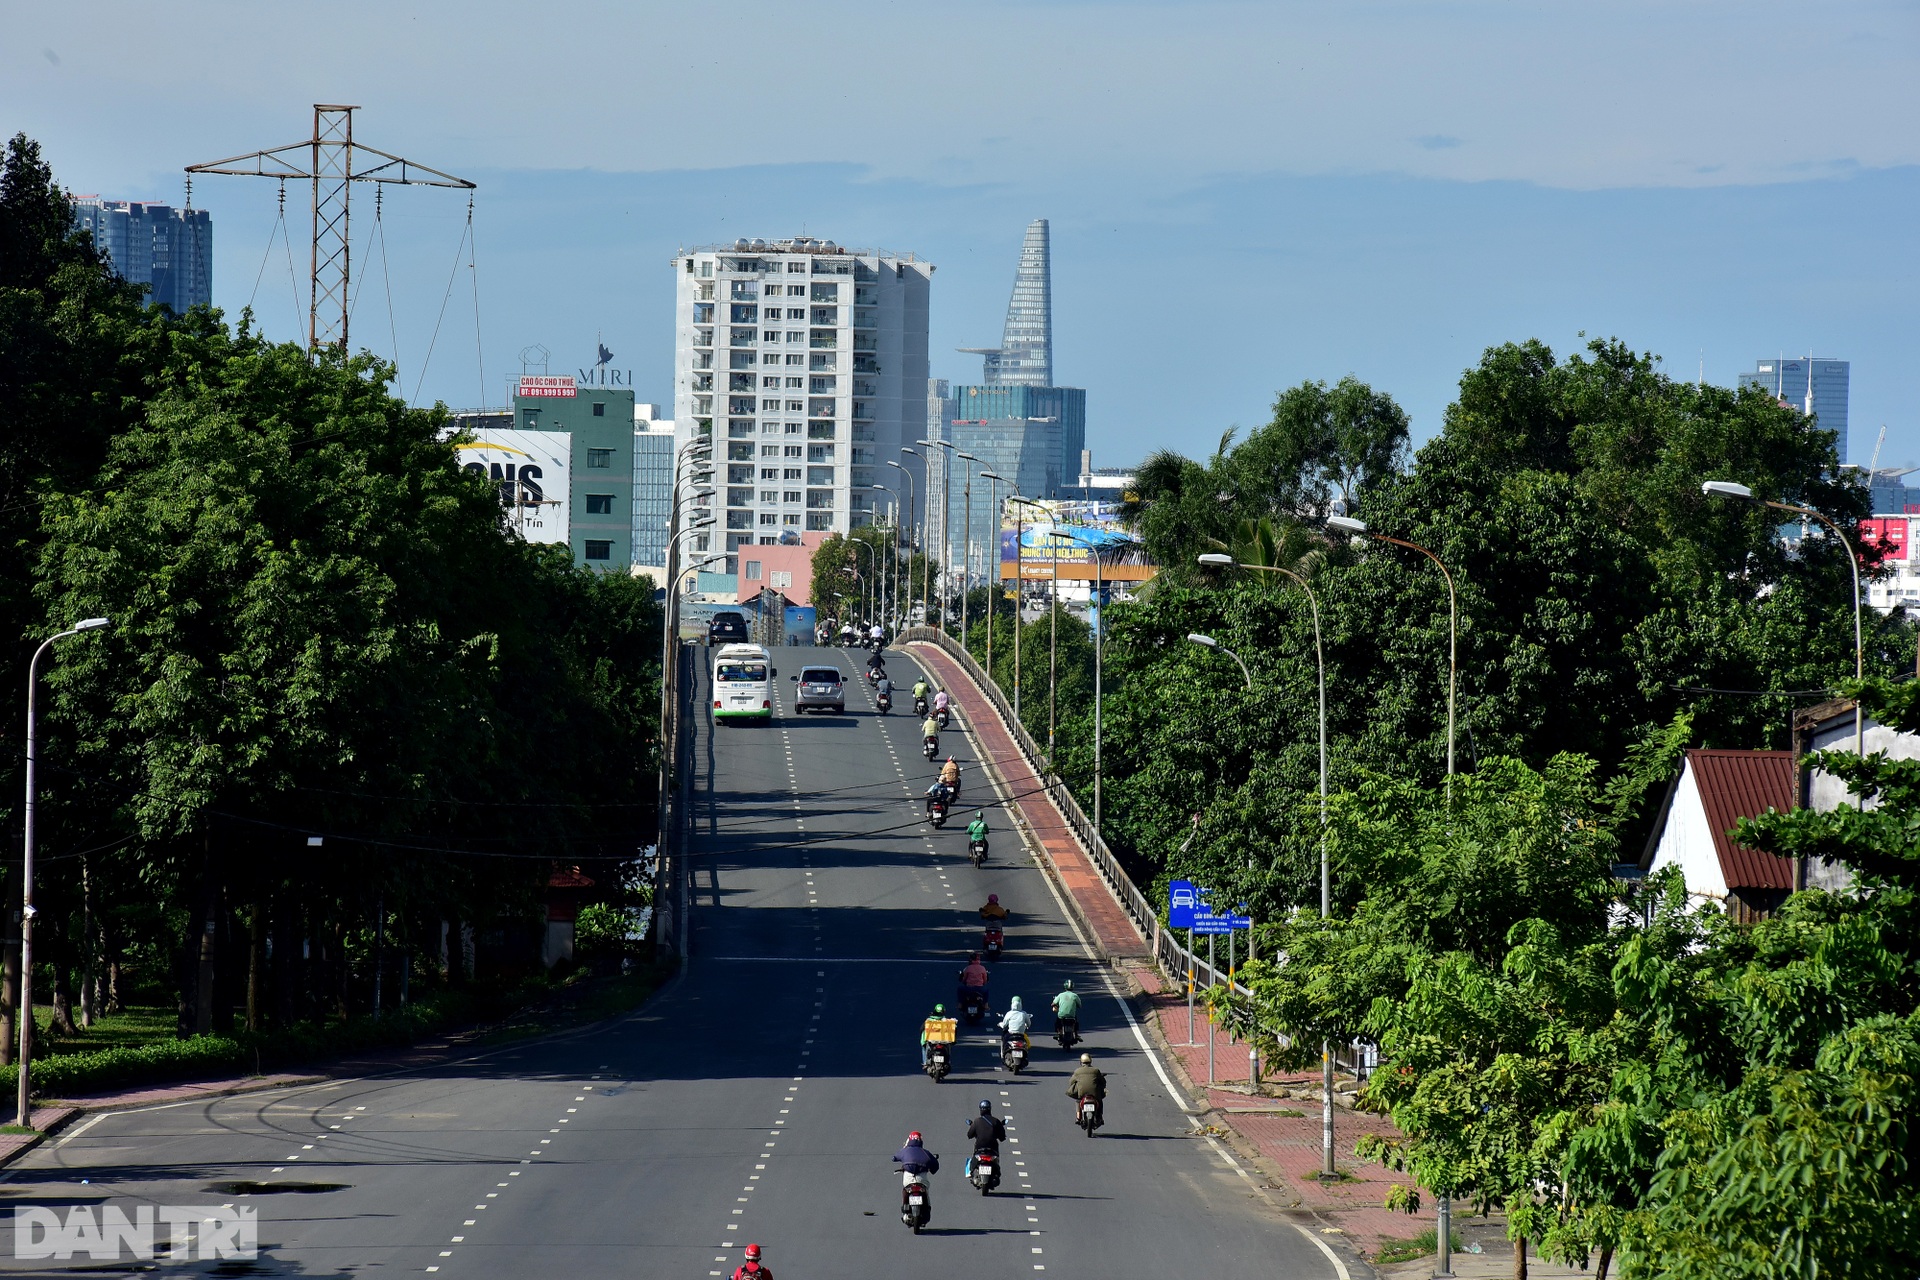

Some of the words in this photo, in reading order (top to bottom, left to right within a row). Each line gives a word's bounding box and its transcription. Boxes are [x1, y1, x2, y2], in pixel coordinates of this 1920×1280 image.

[521, 377, 533, 386] CAO
[544, 378, 557, 386] CHO
[578, 369, 632, 385] MIRI
[525, 517, 543, 528] Tín
